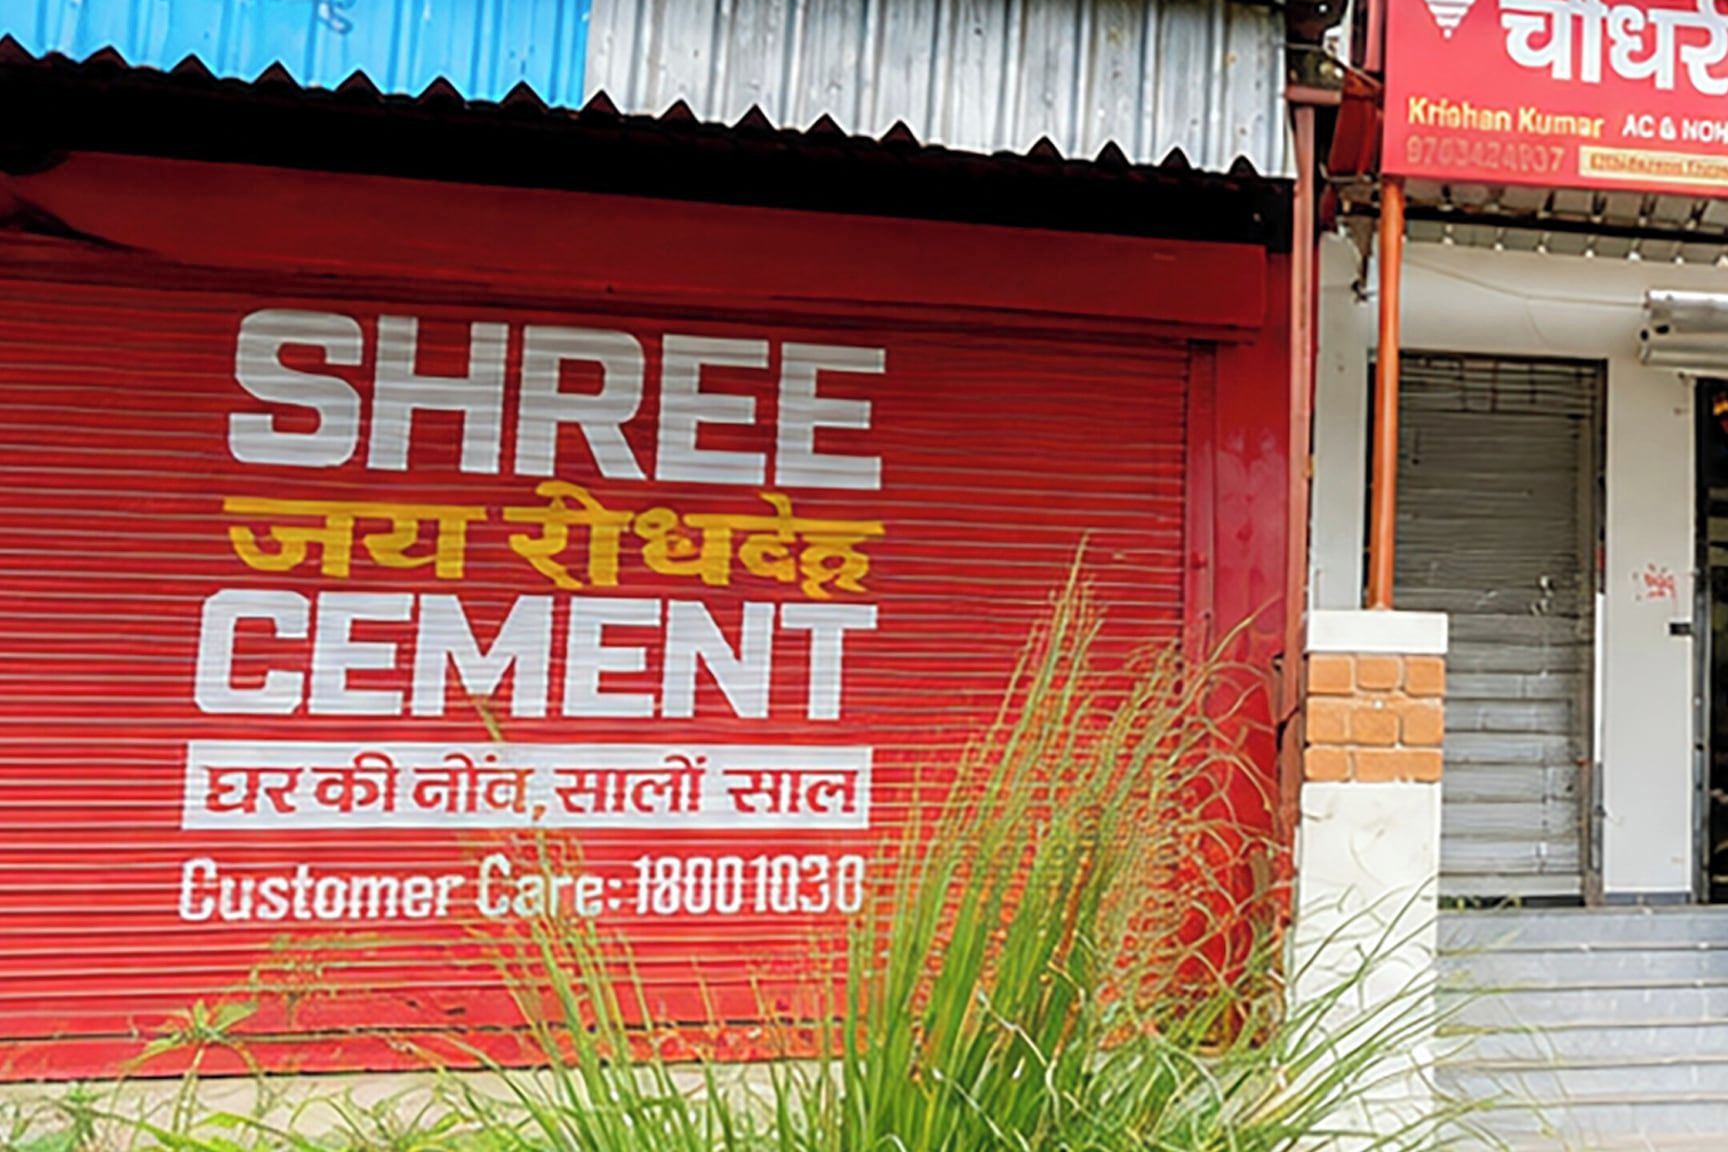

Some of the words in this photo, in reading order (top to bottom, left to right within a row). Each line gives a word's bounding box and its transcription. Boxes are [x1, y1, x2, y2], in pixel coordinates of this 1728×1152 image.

[1408, 97, 1512, 132] Krishan
[1518, 107, 1605, 139] Kumar
[1622, 114, 1655, 137] AC
[228, 308, 886, 491] SHREE
[193, 589, 878, 720] CEMENT
[204, 766, 304, 814] घर
[311, 752, 399, 814] की
[555, 754, 706, 814] सालों
[722, 768, 859, 814] साल
[180, 857, 465, 921] Customer
